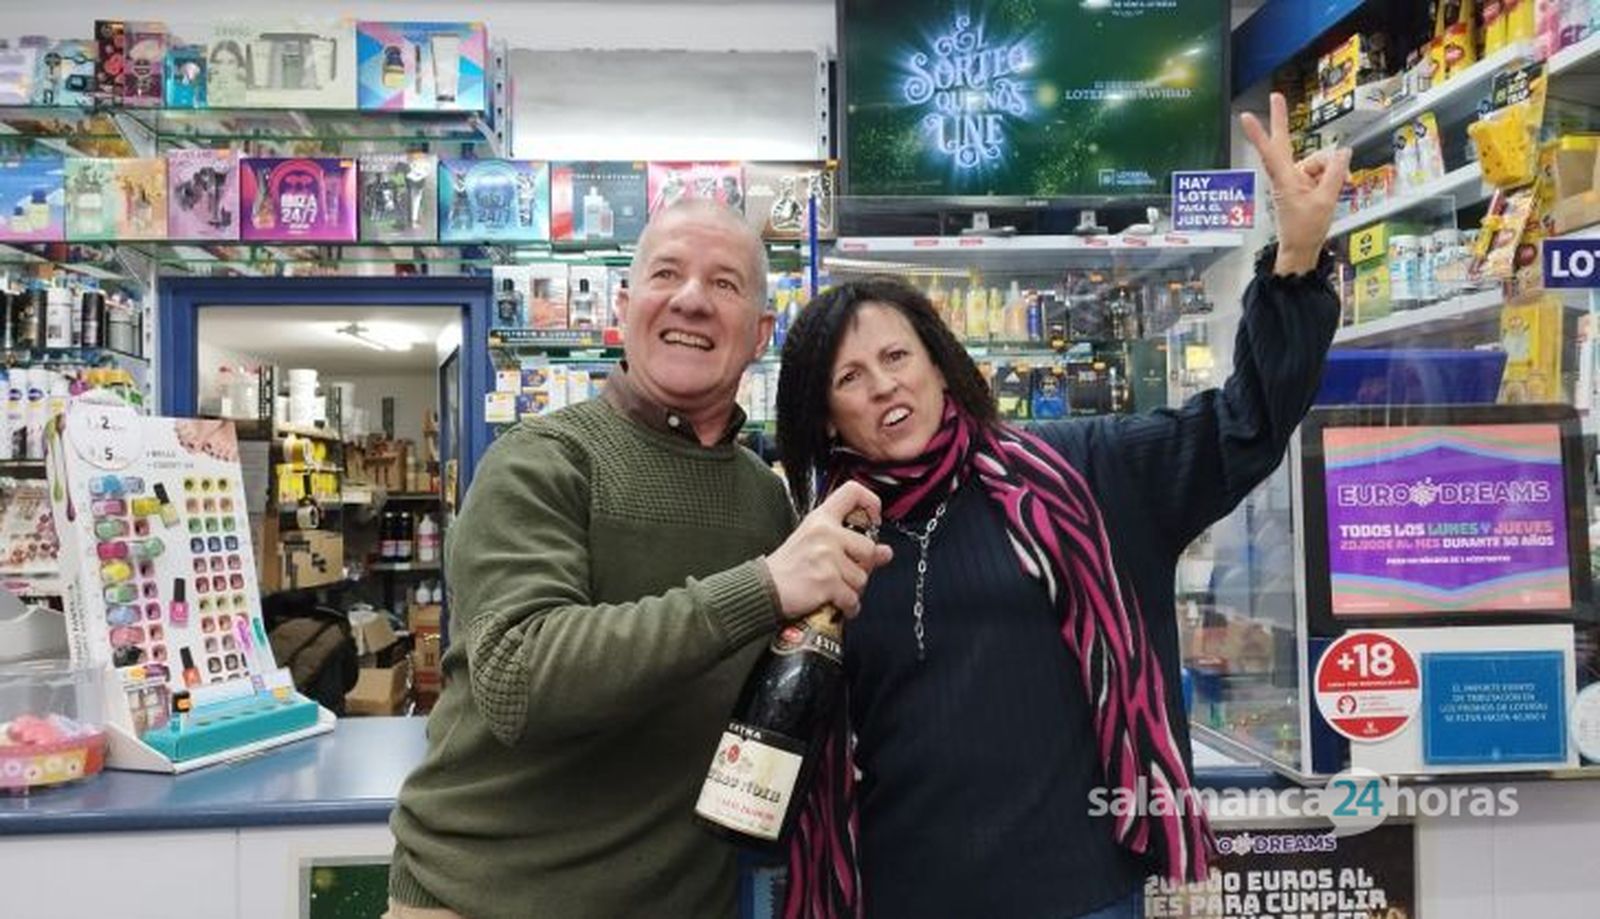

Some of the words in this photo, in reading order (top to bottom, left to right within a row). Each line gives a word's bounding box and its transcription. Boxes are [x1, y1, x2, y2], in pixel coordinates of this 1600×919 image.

[953, 15, 988, 51] EL
[905, 37, 1028, 104] SORTEO
[986, 79, 1028, 115] NOS
[924, 113, 1004, 168] UNE
[1179, 177, 1211, 190] HAY
[281, 208, 316, 224] 24/7
[1177, 214, 1228, 227] JUEVES
[1178, 204, 1206, 213] PARA
[1552, 250, 1600, 277] LO
[1338, 484, 1410, 506] EURO
[1439, 481, 1550, 503] DREAMS
[1339, 525, 1392, 537] TODOS
[1394, 523, 1425, 537] LOS
[1427, 522, 1478, 536] LUNES
[1480, 522, 1490, 534] Y
[1494, 520, 1554, 534] JUEVES
[1443, 537, 1499, 549] DURANTE
[1521, 534, 1554, 546] AÑOS
[1337, 643, 1396, 678] +18
[1252, 834, 1337, 854] DREAMS
[1247, 869, 1334, 892] EUROS
[1340, 867, 1374, 889] AL
[1190, 892, 1261, 916] PARA
[1265, 888, 1388, 914] CUMPLIR
